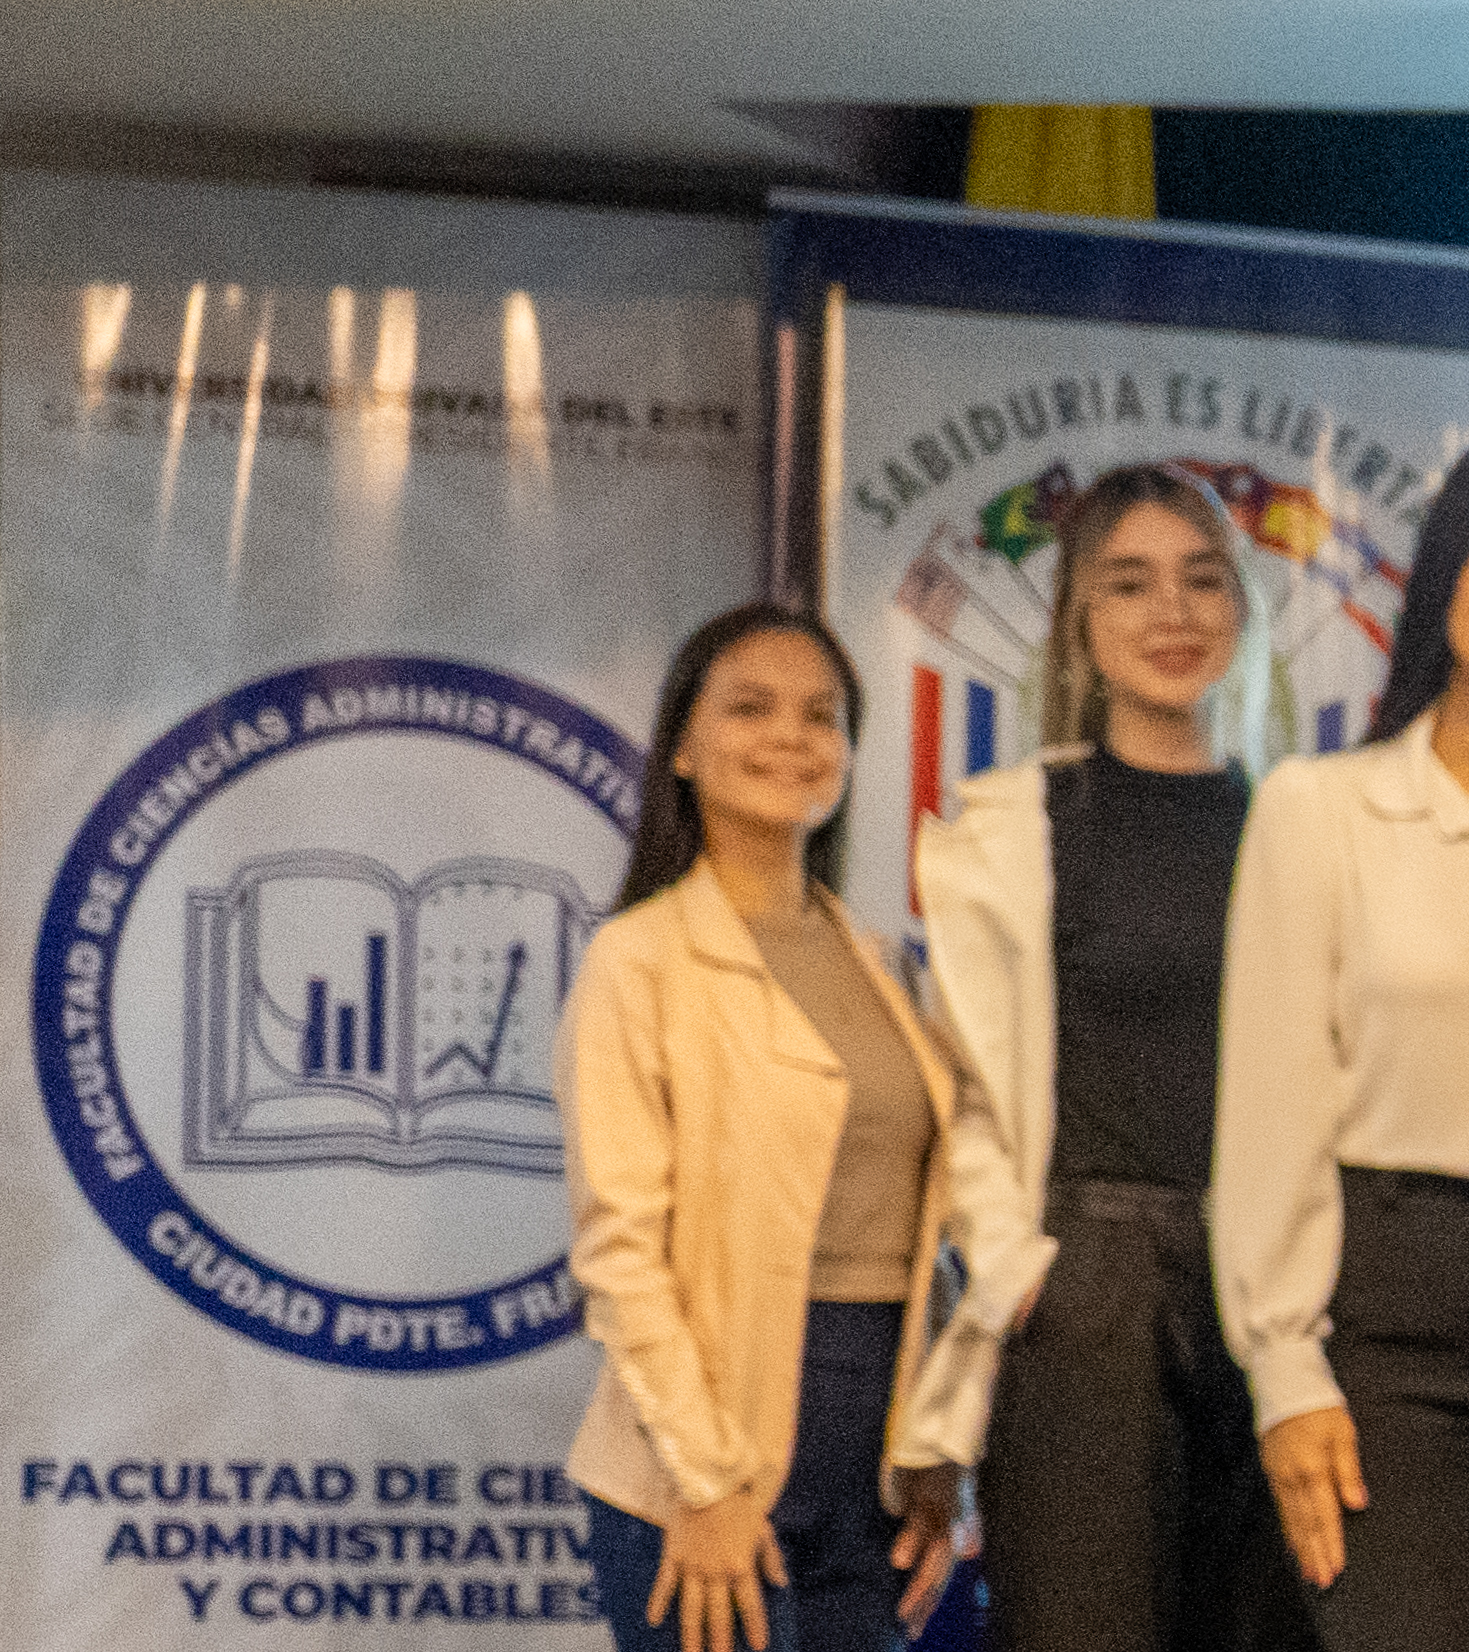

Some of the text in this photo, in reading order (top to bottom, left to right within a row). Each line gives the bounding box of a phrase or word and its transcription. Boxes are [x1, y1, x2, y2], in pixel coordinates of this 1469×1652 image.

[1166, 372, 1221, 429] ES
[62, 683, 643, 1182] FACULTAD DE CIENCIAS ADMINISTRATIV
[147, 1210, 326, 1338] CIUDAD
[333, 1307, 485, 1352] PDTE.
[22, 1459, 354, 1507] FACULTAD
[375, 1461, 465, 1507] DE
[180, 1579, 604, 1625] Y CONTABLES
